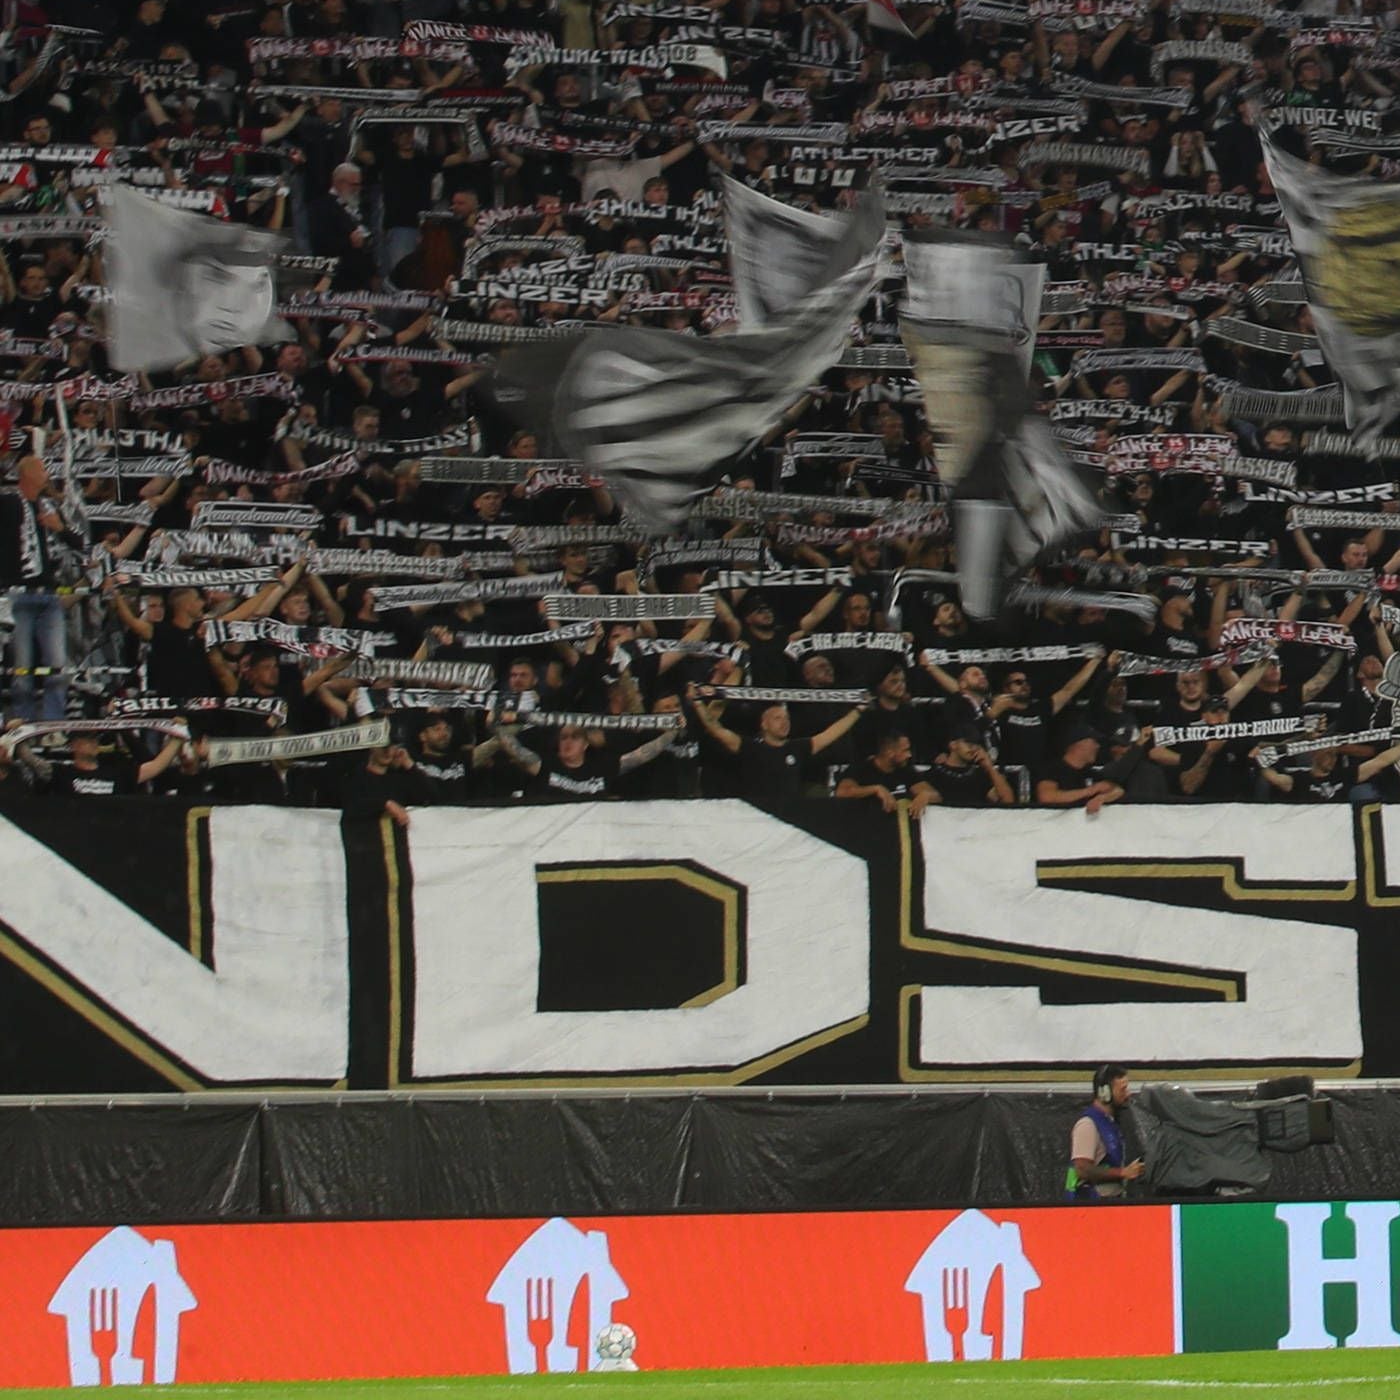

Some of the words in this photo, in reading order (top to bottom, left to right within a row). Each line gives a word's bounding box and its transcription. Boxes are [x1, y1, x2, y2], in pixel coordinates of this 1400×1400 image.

[790, 145, 940, 164] ATHLETIKER
[1243, 482, 1394, 504] LINZER
[1111, 531, 1269, 556] LINZER
